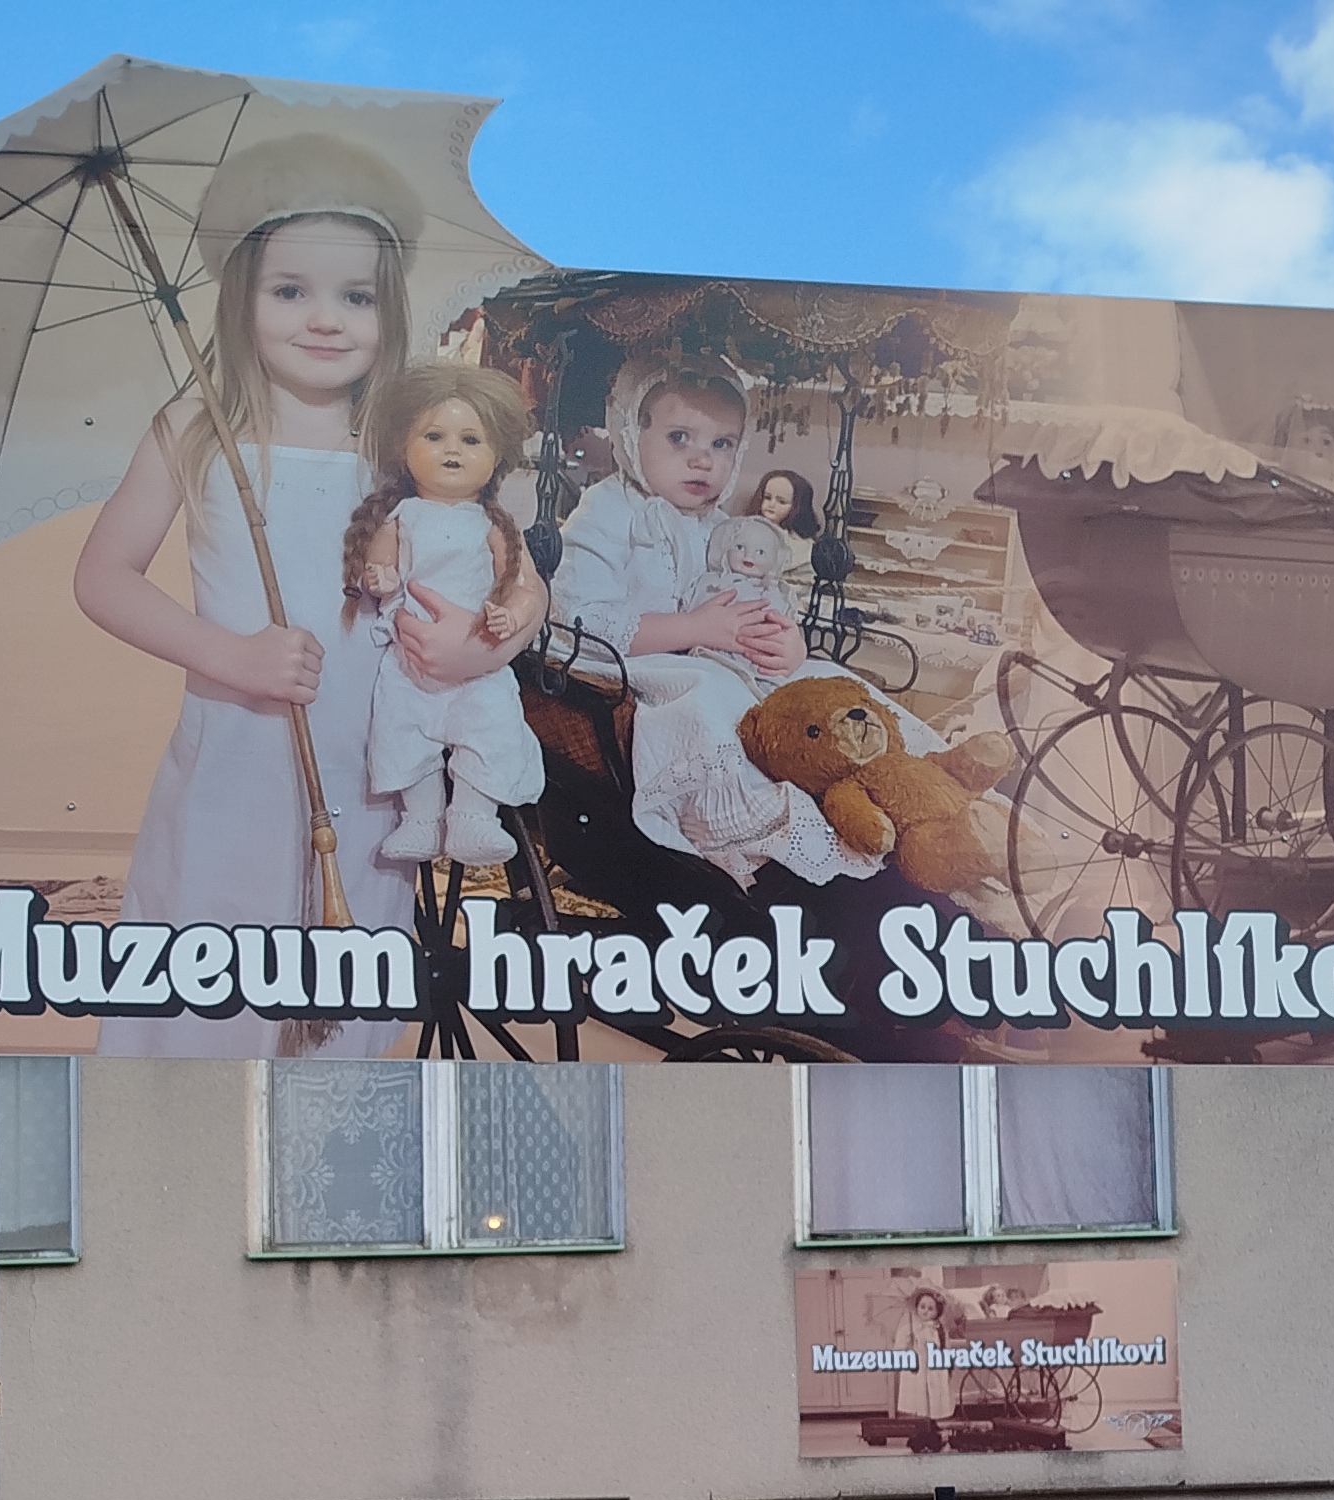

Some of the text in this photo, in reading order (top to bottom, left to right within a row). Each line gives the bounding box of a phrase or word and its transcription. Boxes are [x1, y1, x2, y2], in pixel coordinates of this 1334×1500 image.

[462, 898, 857, 1024] hraček
[812, 1336, 1166, 1372] Muzeum hraček Stuchlíkovi
